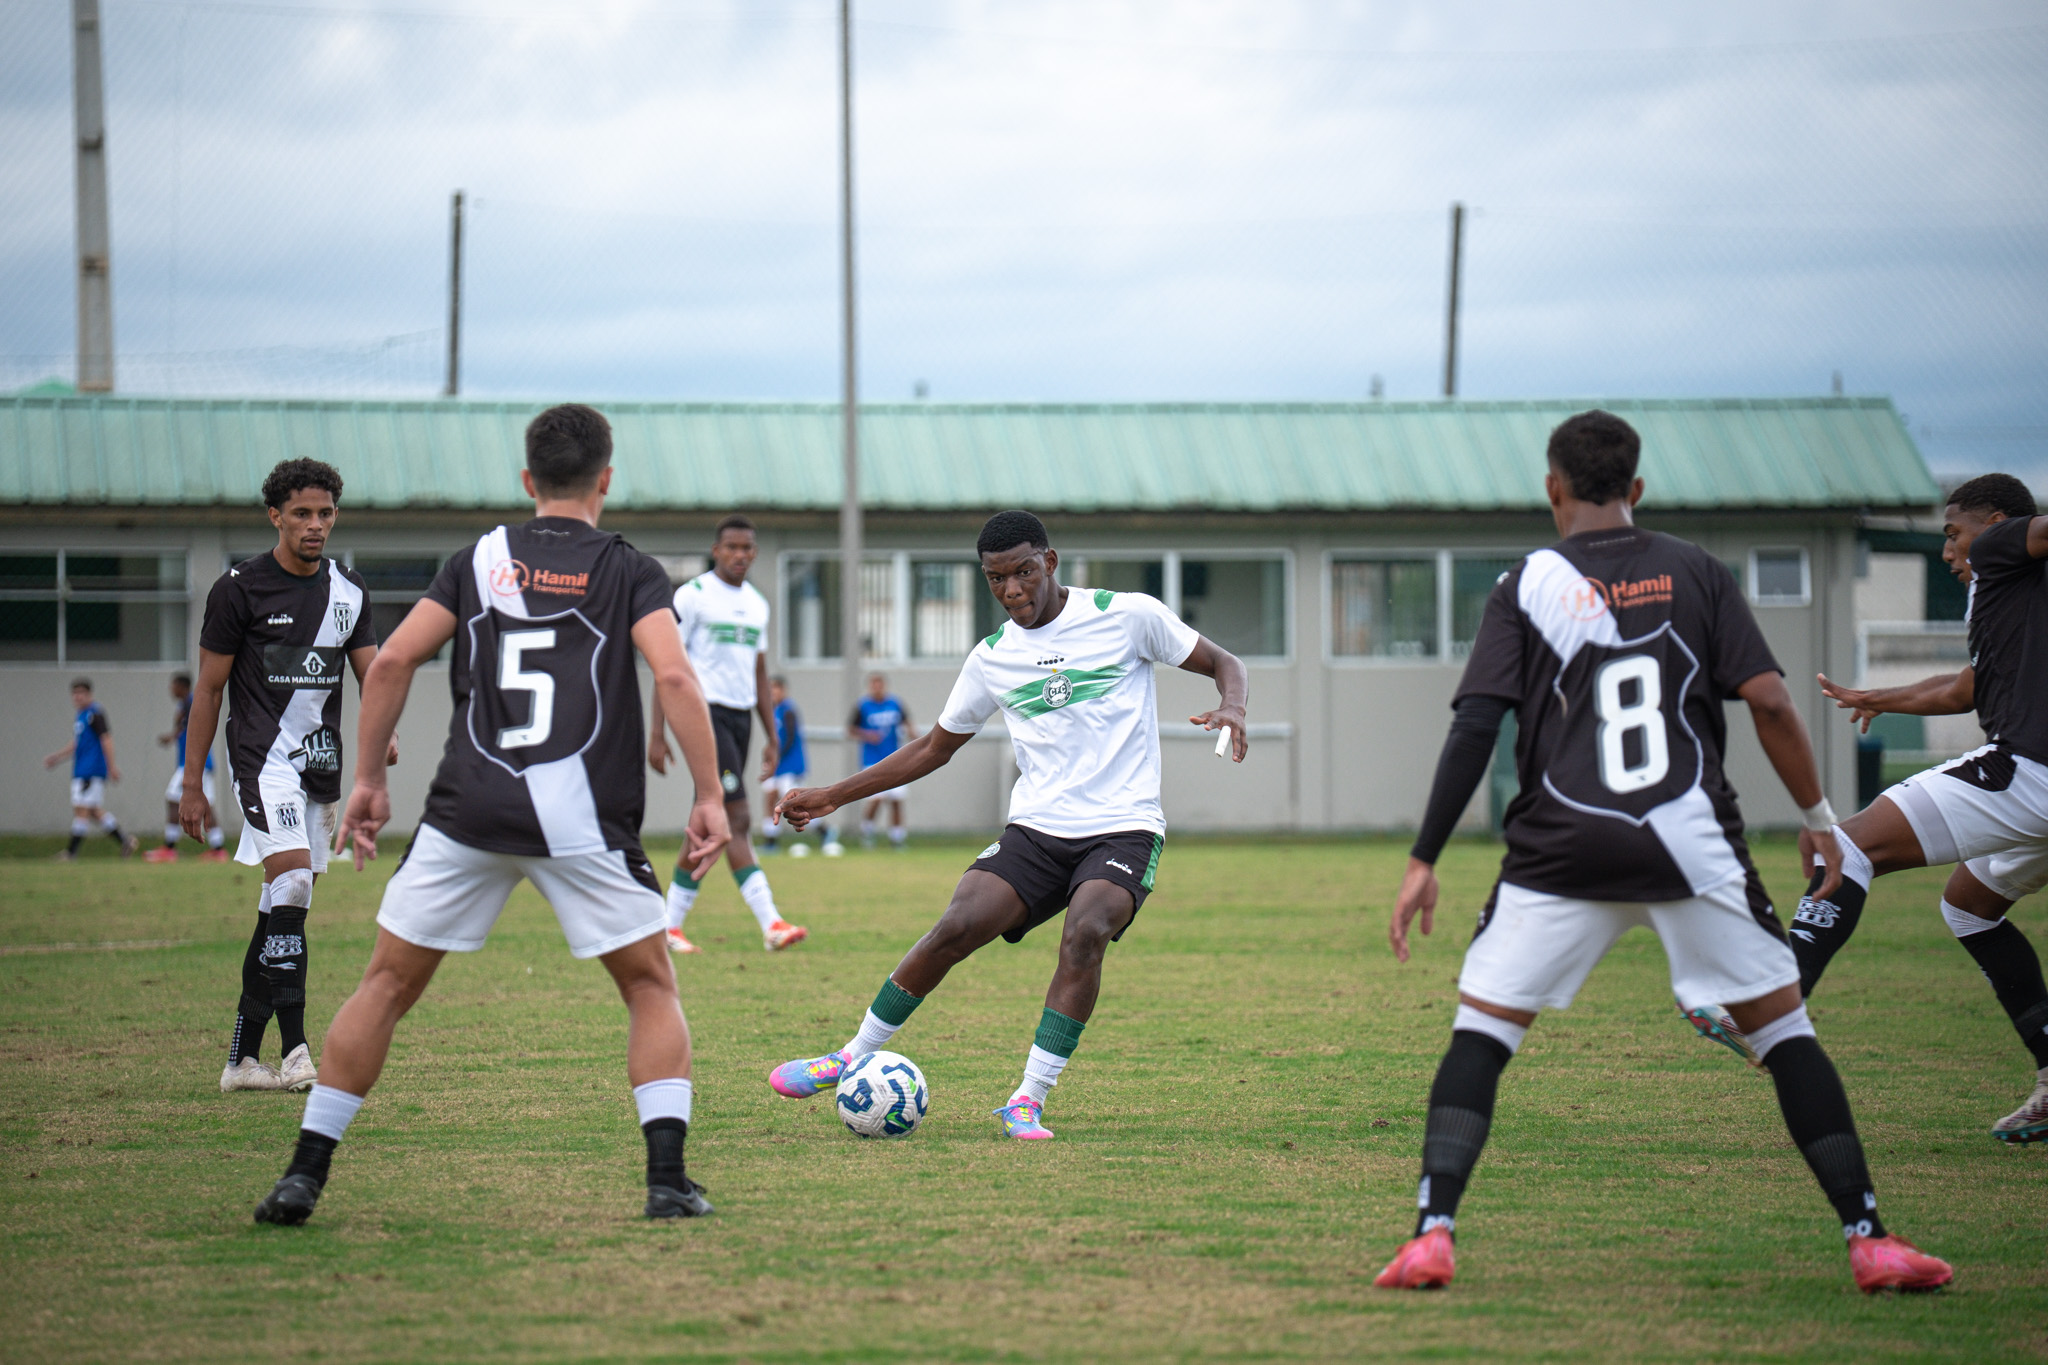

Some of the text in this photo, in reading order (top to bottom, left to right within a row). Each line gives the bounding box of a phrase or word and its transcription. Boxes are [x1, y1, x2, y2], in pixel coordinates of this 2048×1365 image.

[533, 569, 588, 587] Hamil
[1611, 574, 1672, 598] Hamil
[533, 583, 586, 595] Transportes
[268, 675, 290, 684] CASA
[291, 675, 316, 684] MARIA
[317, 676, 326, 684] DE
[496, 627, 556, 750] 5
[1593, 653, 1669, 795] 8
